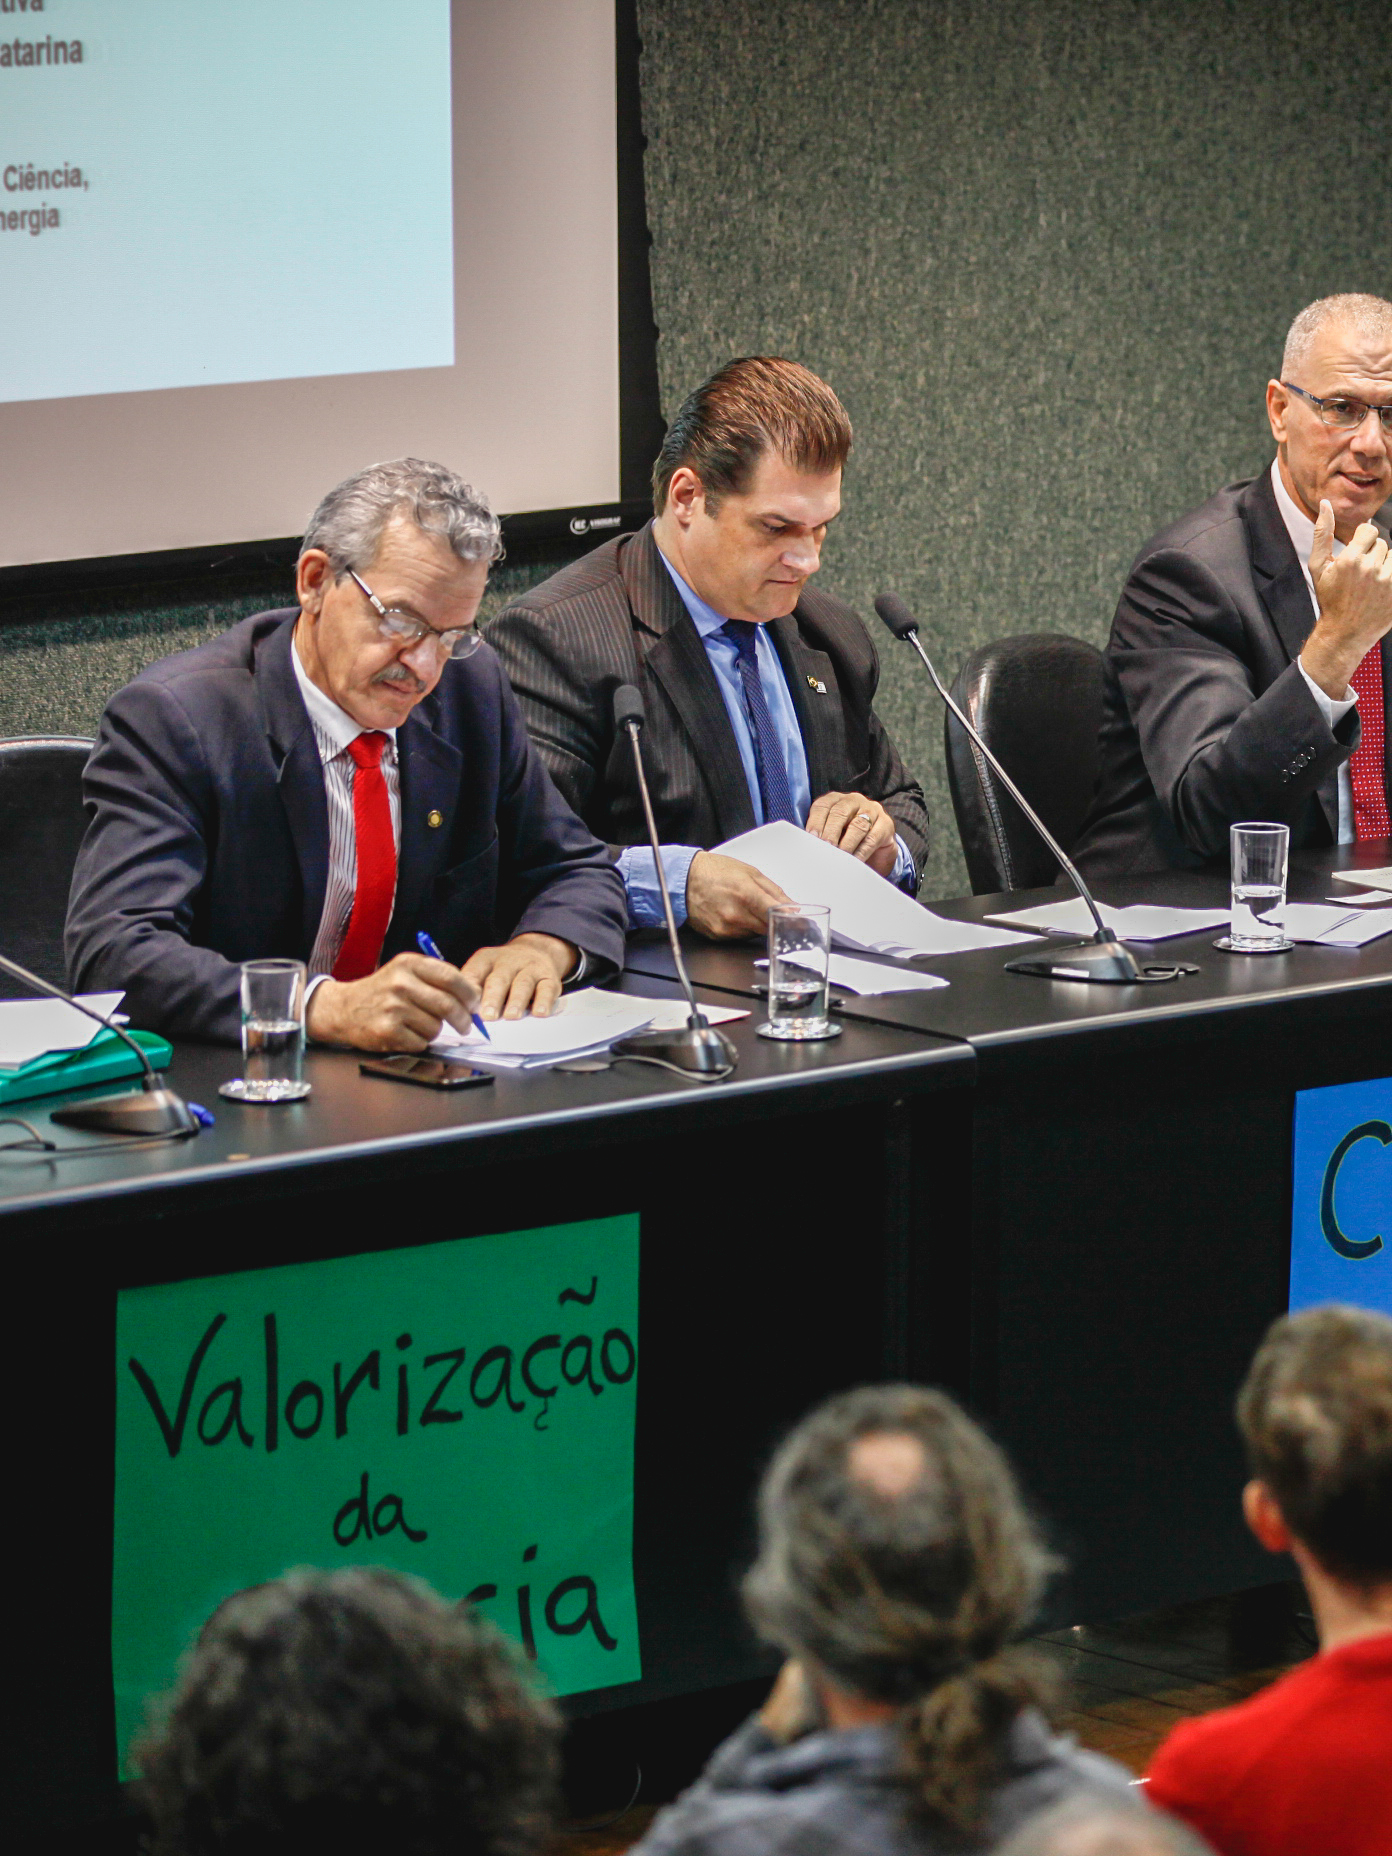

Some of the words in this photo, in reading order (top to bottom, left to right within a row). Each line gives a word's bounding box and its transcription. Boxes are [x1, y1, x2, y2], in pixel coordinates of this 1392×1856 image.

[0, 35, 83, 67] atarina
[3, 162, 89, 192] Ciência,
[129, 1275, 636, 1458] Valorização
[333, 1471, 428, 1546] da
